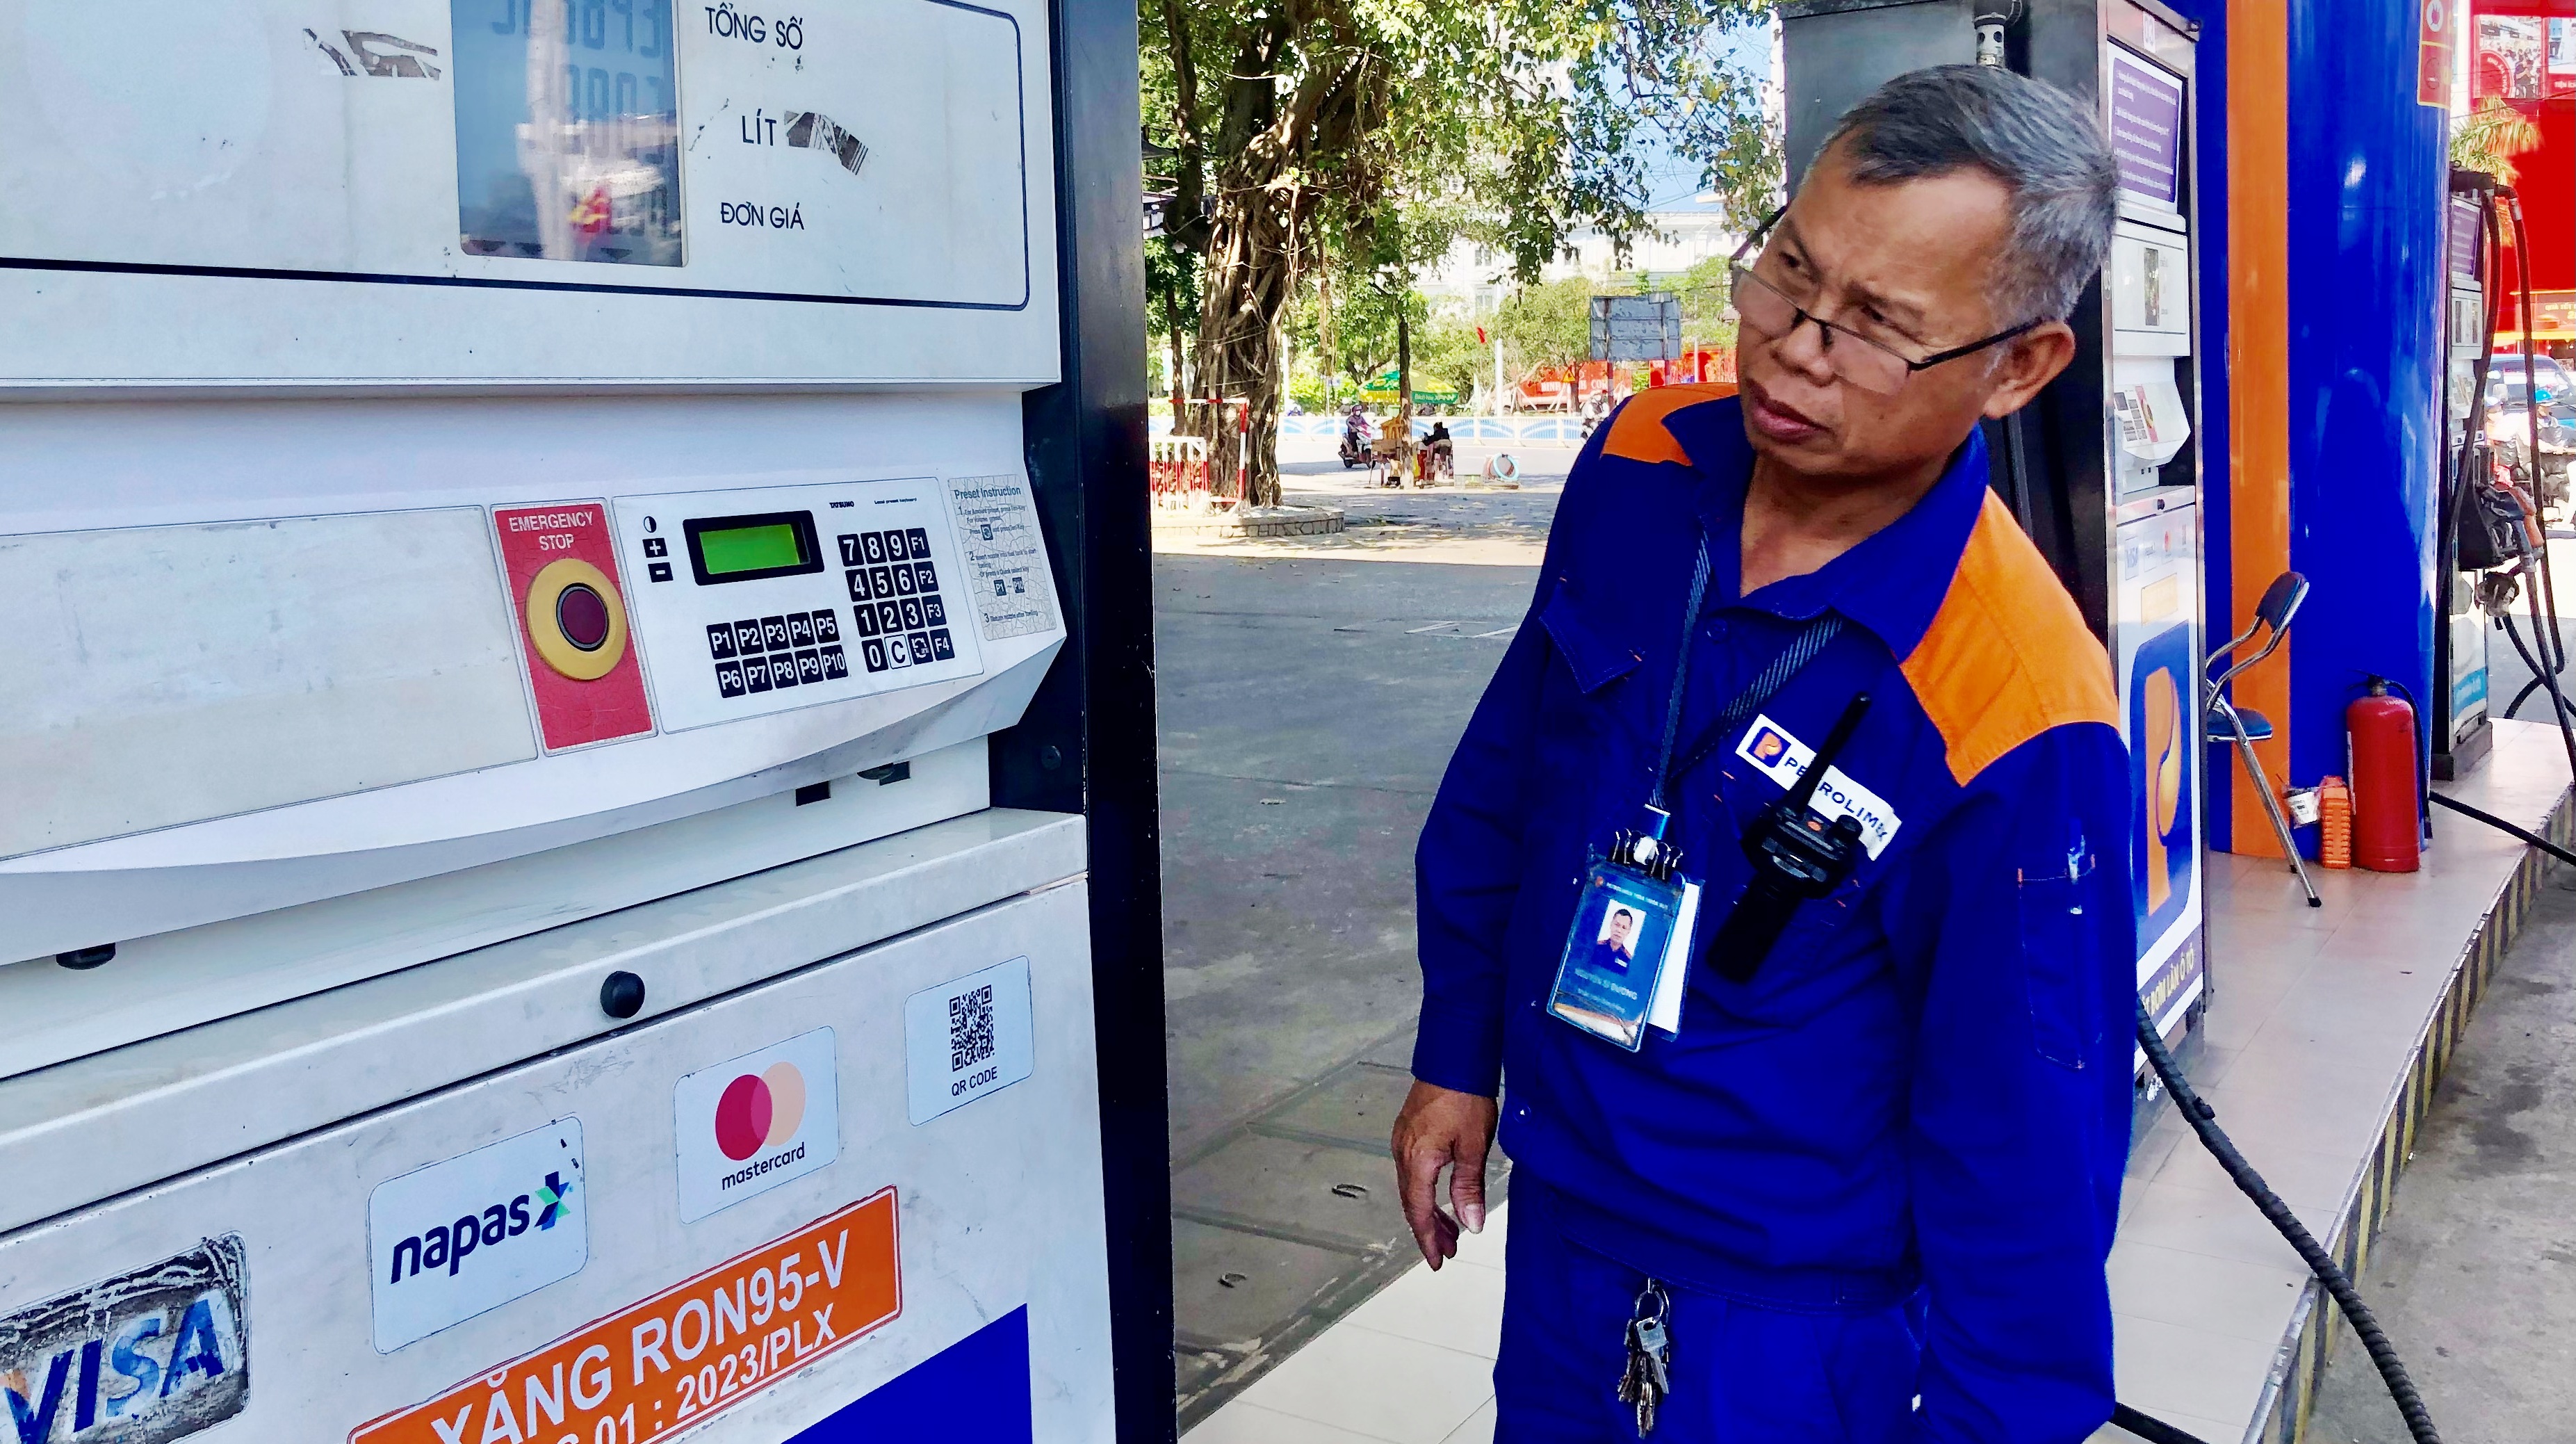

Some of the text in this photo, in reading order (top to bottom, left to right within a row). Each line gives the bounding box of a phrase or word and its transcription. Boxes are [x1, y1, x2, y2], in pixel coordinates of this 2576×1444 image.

[705, 2, 766, 43] TỔNG
[776, 16, 803, 50] SỐ
[742, 108, 776, 146] LÍT
[720, 202, 804, 230] ĐƠN GIÁ
[954, 486, 1021, 499] Preset Instruction
[509, 512, 593, 533] EMERGENCY
[539, 534, 574, 551] STOP
[844, 535, 925, 561] 7 8 9 F1
[970, 551, 975, 561] 2
[854, 569, 934, 596] 4 5 6 F2
[995, 583, 1004, 592] P1
[861, 603, 942, 631] 1 2 3 F3
[984, 613, 989, 623] 3
[711, 617, 835, 651] P1 P2 P3 P4 P5
[869, 638, 949, 667] 0 C F4
[719, 653, 845, 690] P6 P7 P8 P9 P10
[952, 1066, 997, 1097] QR CODE
[722, 1142, 805, 1190] mastercard
[391, 1194, 530, 1284] napas
[633, 1228, 849, 1386] RON95-V
[4, 1298, 225, 1444] VISA
[676, 1303, 836, 1420] 2023/PLX
